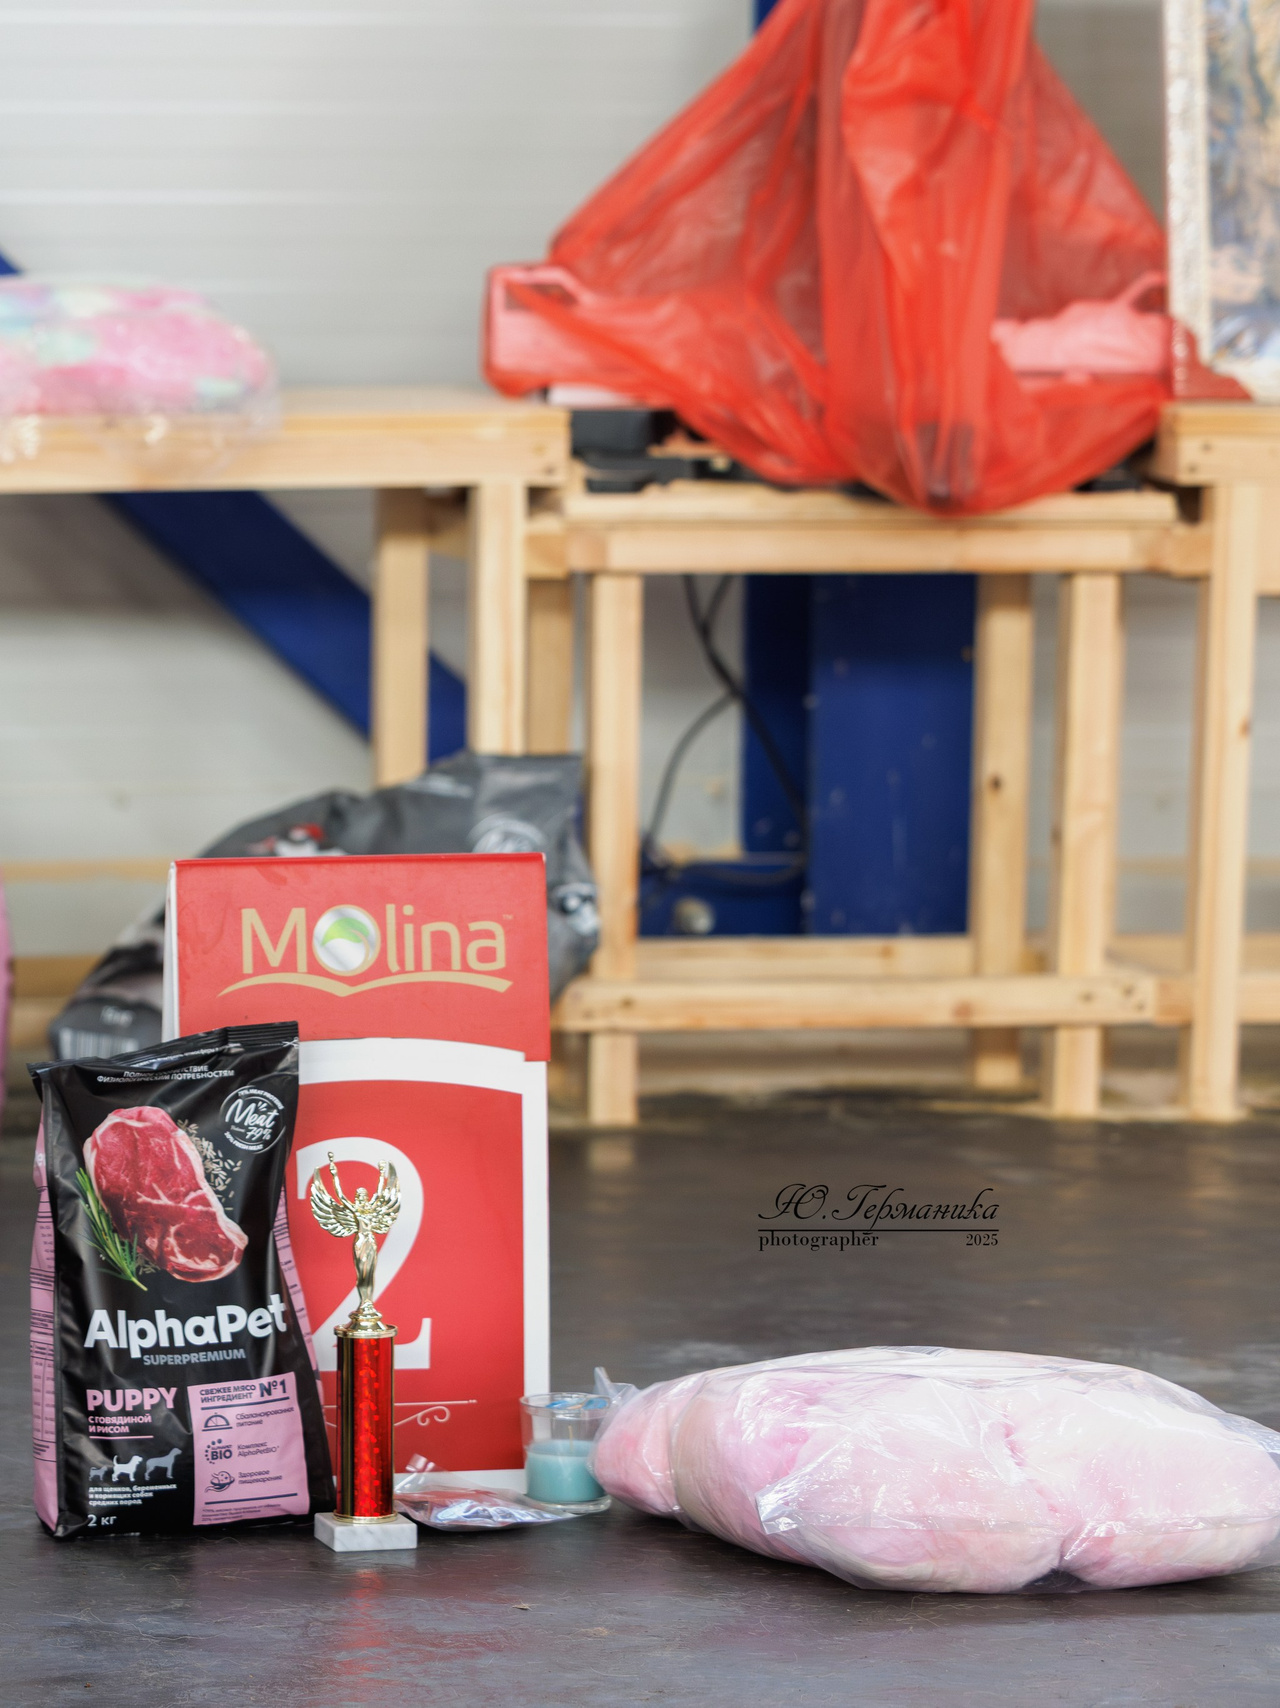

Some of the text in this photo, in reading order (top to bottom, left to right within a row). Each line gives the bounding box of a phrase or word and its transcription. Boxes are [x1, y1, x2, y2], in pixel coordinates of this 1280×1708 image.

[170, 1070, 235, 1080] ПОТРЕБНОСТЯМ
[225, 1098, 280, 1129] Meat
[245, 1126, 273, 1141] 79%
[296, 1137, 432, 1372] 2
[83, 1293, 288, 1359] AlphaPet
[143, 1348, 247, 1366] SUPERPREMIUM
[200, 1384, 257, 1396] СВЕЖЕЕ МЯСО
[86, 1387, 178, 1412] PUPPY
[200, 1392, 253, 1403] ИНГРЕДИЕНТ
[95, 1413, 153, 1425] ГОВЯДИНОЙ
[235, 1406, 295, 1420] Сбалансированное
[96, 1425, 131, 1434] РИСОМ
[235, 1419, 264, 1428] питание
[237, 1441, 268, 1450] Комплекс
[211, 1449, 233, 1461] BIO
[238, 1470, 270, 1479] Здоровое
[238, 1475, 283, 1485] пищеварение
[132, 1483, 178, 1492] беременных
[88, 1498, 143, 1507] средних пород
[87, 1514, 118, 1527] 2 кг
